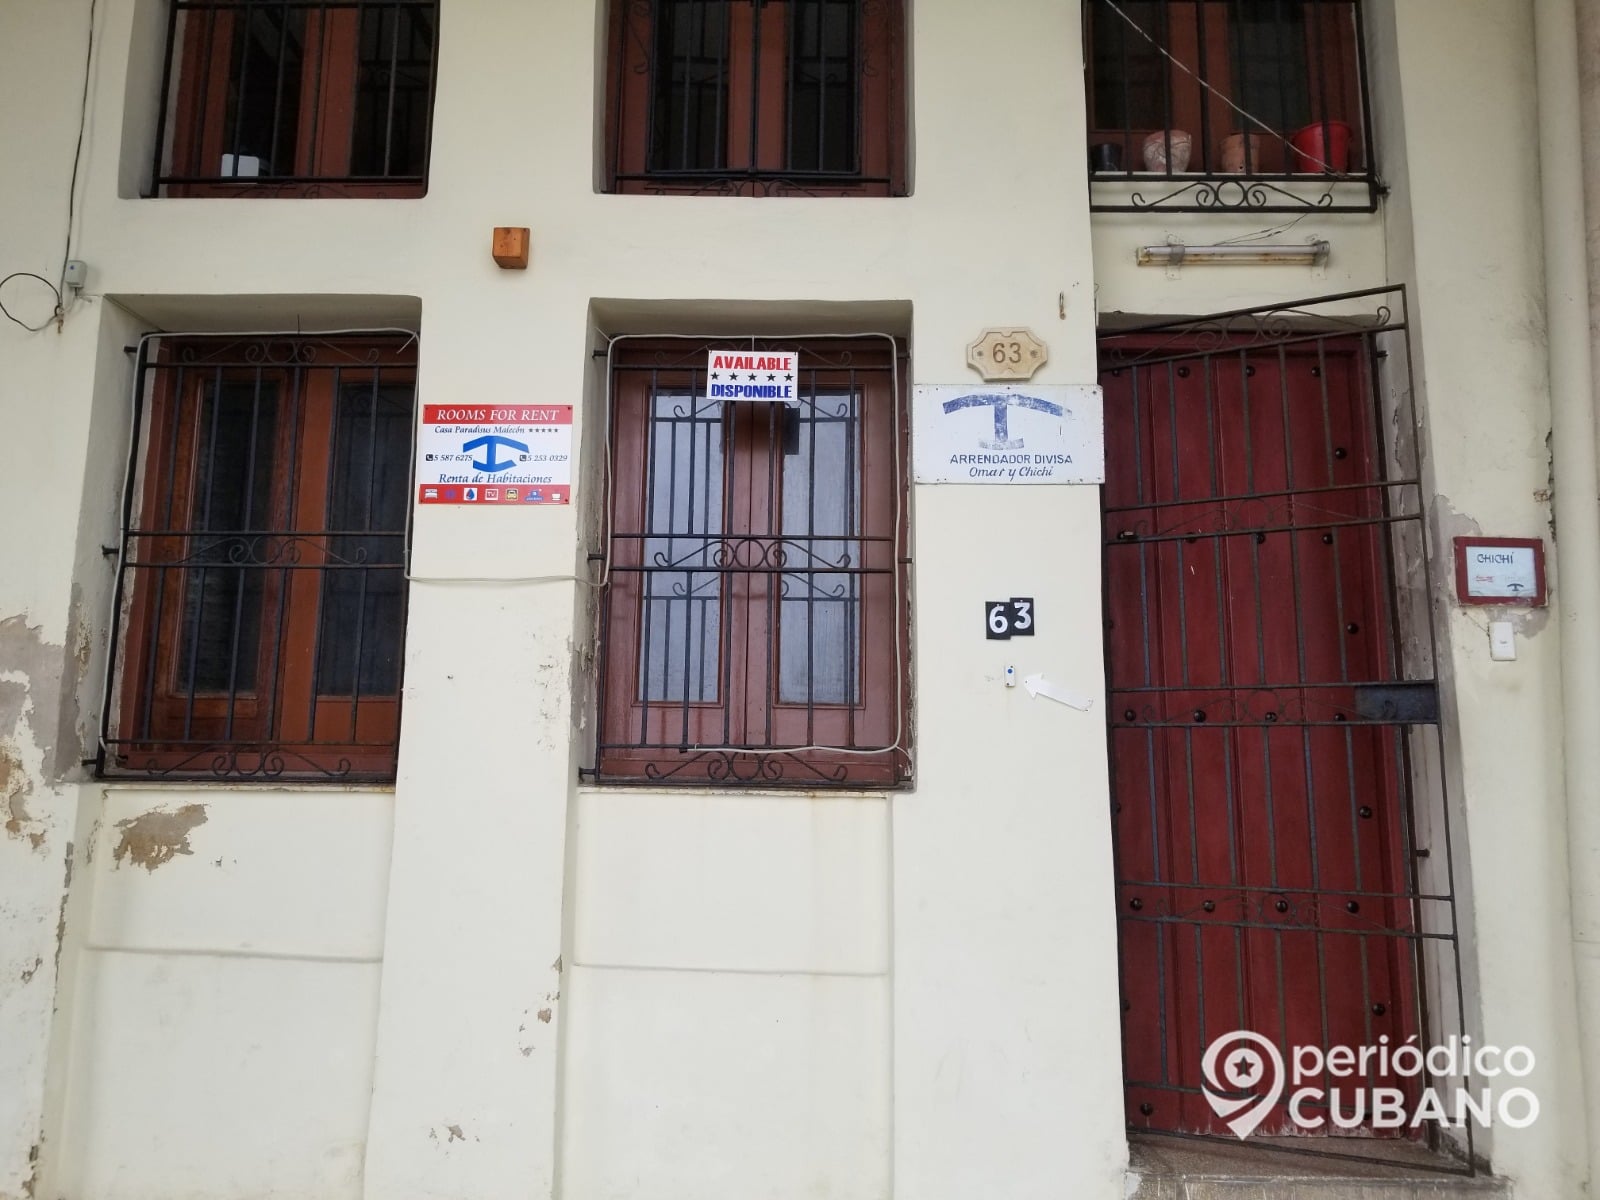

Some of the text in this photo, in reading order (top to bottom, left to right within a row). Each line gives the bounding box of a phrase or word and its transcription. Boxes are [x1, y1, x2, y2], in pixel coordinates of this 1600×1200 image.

[992, 342, 1022, 363] 63
[713, 355, 792, 370] AVAILABLE
[711, 384, 792, 398] DISPONIBLE
[437, 409, 560, 421] ROOMS FOR RENT
[434, 425, 525, 433] Casa Paradisus Malecón
[950, 454, 1073, 465] ARRENDADOR DIVISA
[439, 472, 552, 484] Renta de Habitaciones
[969, 466, 1005, 477] Omar
[1008, 468, 1017, 482] y
[989, 602, 1032, 634] 63
